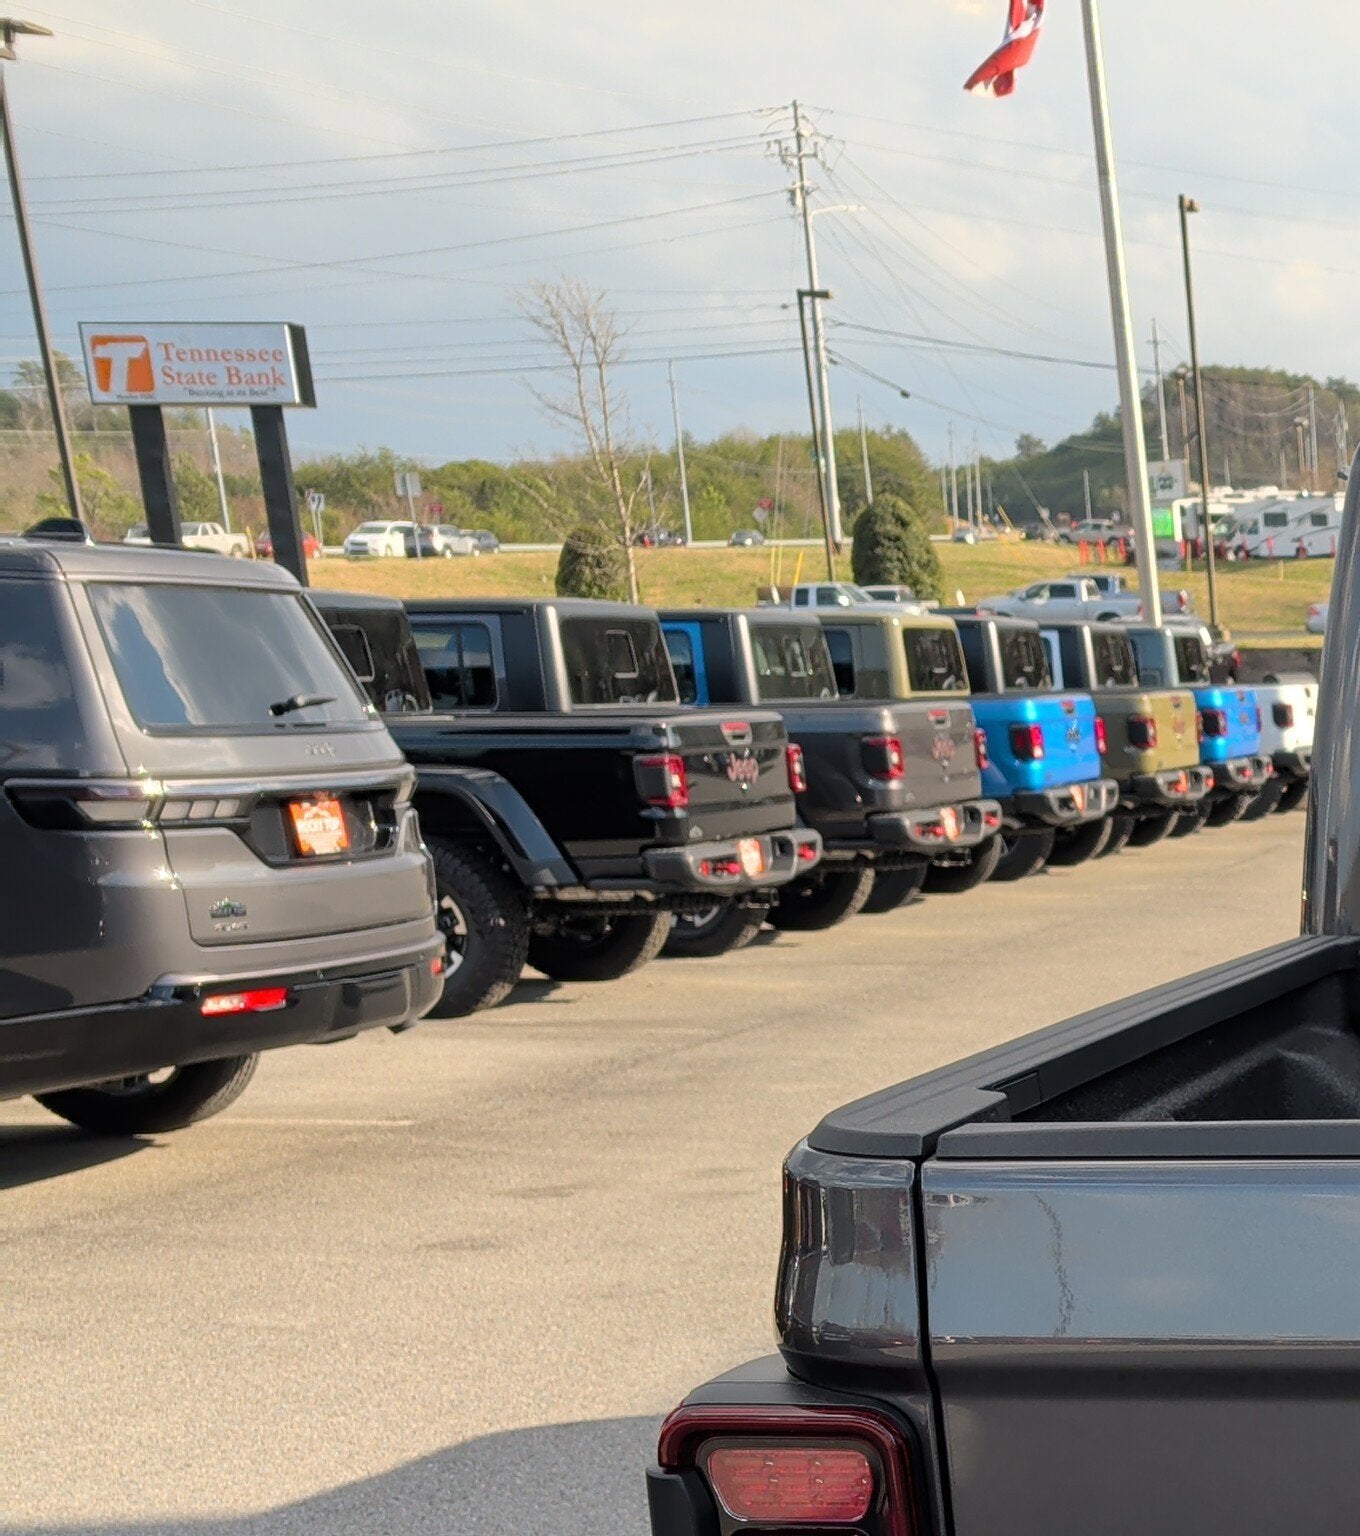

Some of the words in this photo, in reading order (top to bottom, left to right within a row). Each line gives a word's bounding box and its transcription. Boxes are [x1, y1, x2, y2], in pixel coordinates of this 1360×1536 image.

[157, 341, 284, 362] Tennessee
[160, 365, 217, 386] State
[226, 365, 286, 386] Bank
